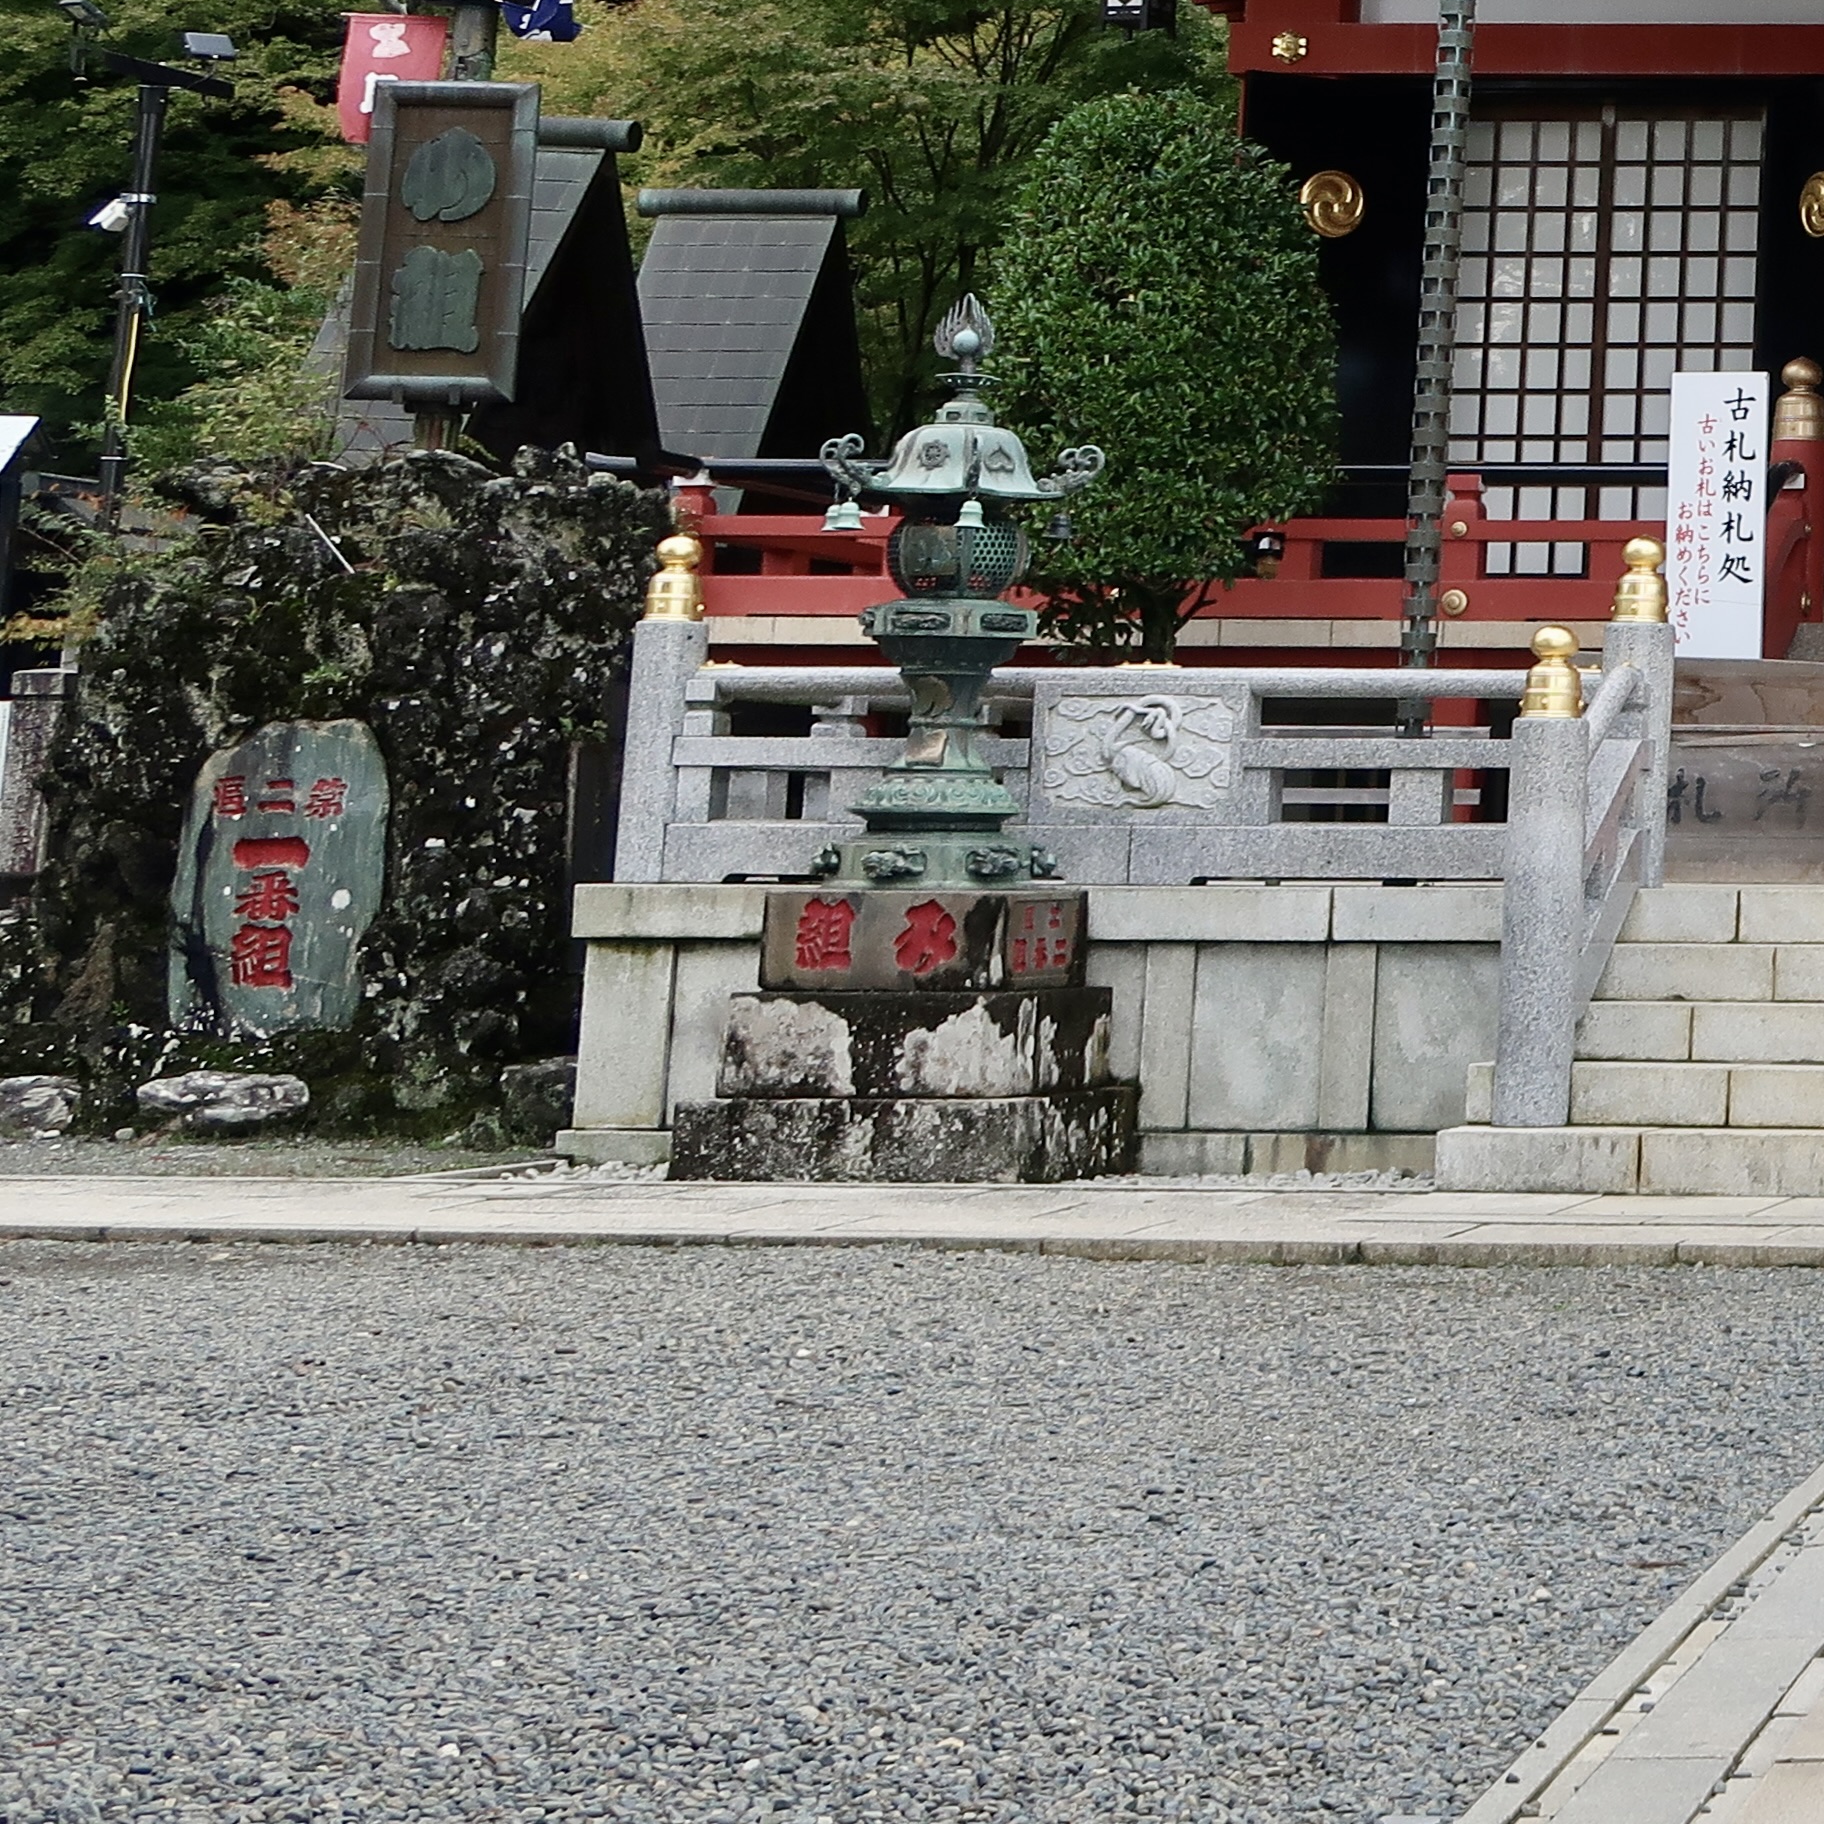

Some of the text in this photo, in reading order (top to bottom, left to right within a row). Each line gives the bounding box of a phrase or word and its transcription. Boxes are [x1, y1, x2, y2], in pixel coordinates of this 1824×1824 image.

[1695, 414, 1718, 605] 古いお札はこちらに
[1718, 387, 1757, 584] 古札納札処
[1673, 501, 1695, 646] お納めください
[231, 835, 311, 991] 一番組
